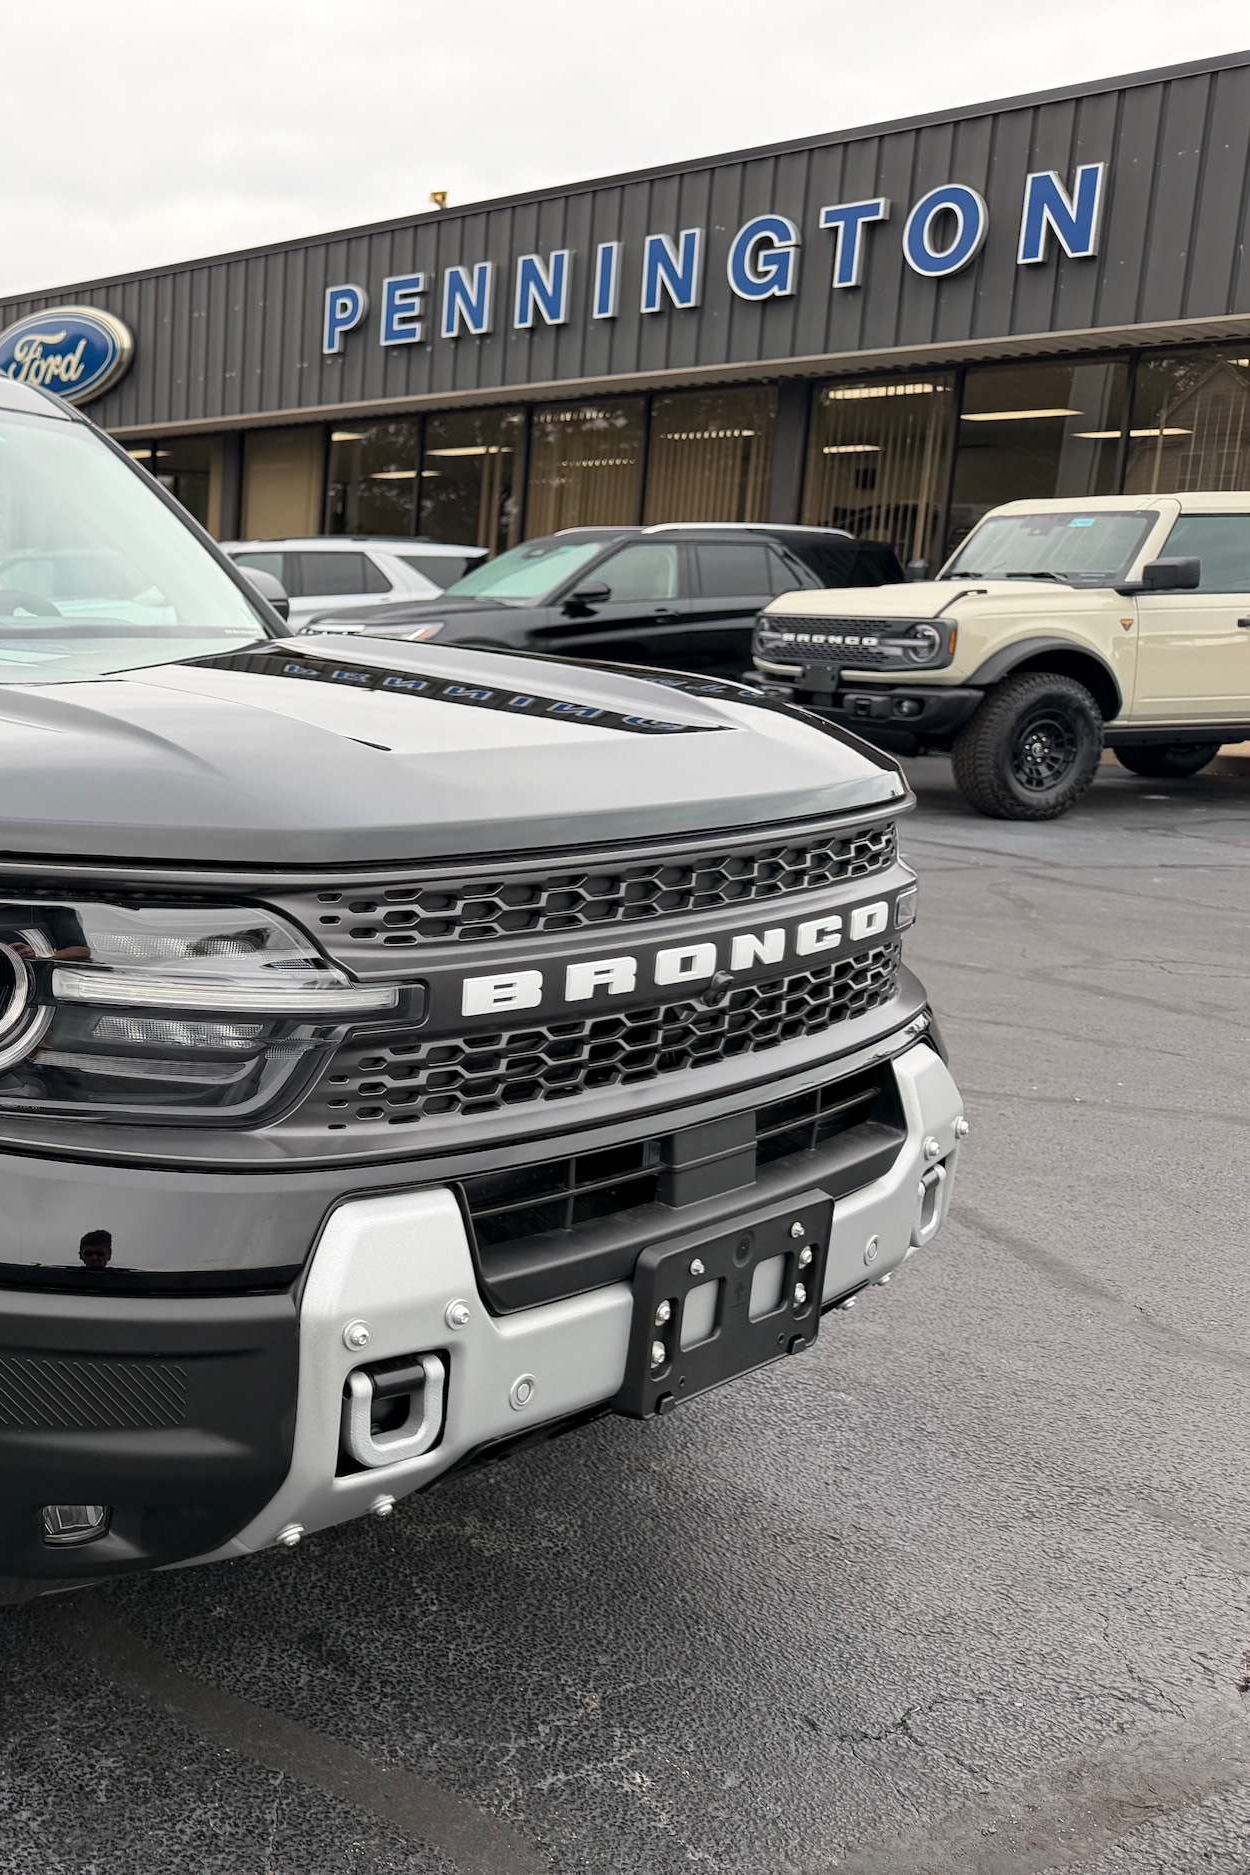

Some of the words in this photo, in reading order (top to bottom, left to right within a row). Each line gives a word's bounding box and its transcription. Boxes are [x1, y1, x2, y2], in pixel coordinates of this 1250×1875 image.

[322, 161, 1108, 355] PENNINGTON
[7, 329, 88, 385] Ford
[781, 632, 879, 647] BRONCO
[461, 900, 889, 1017] BRONCO
